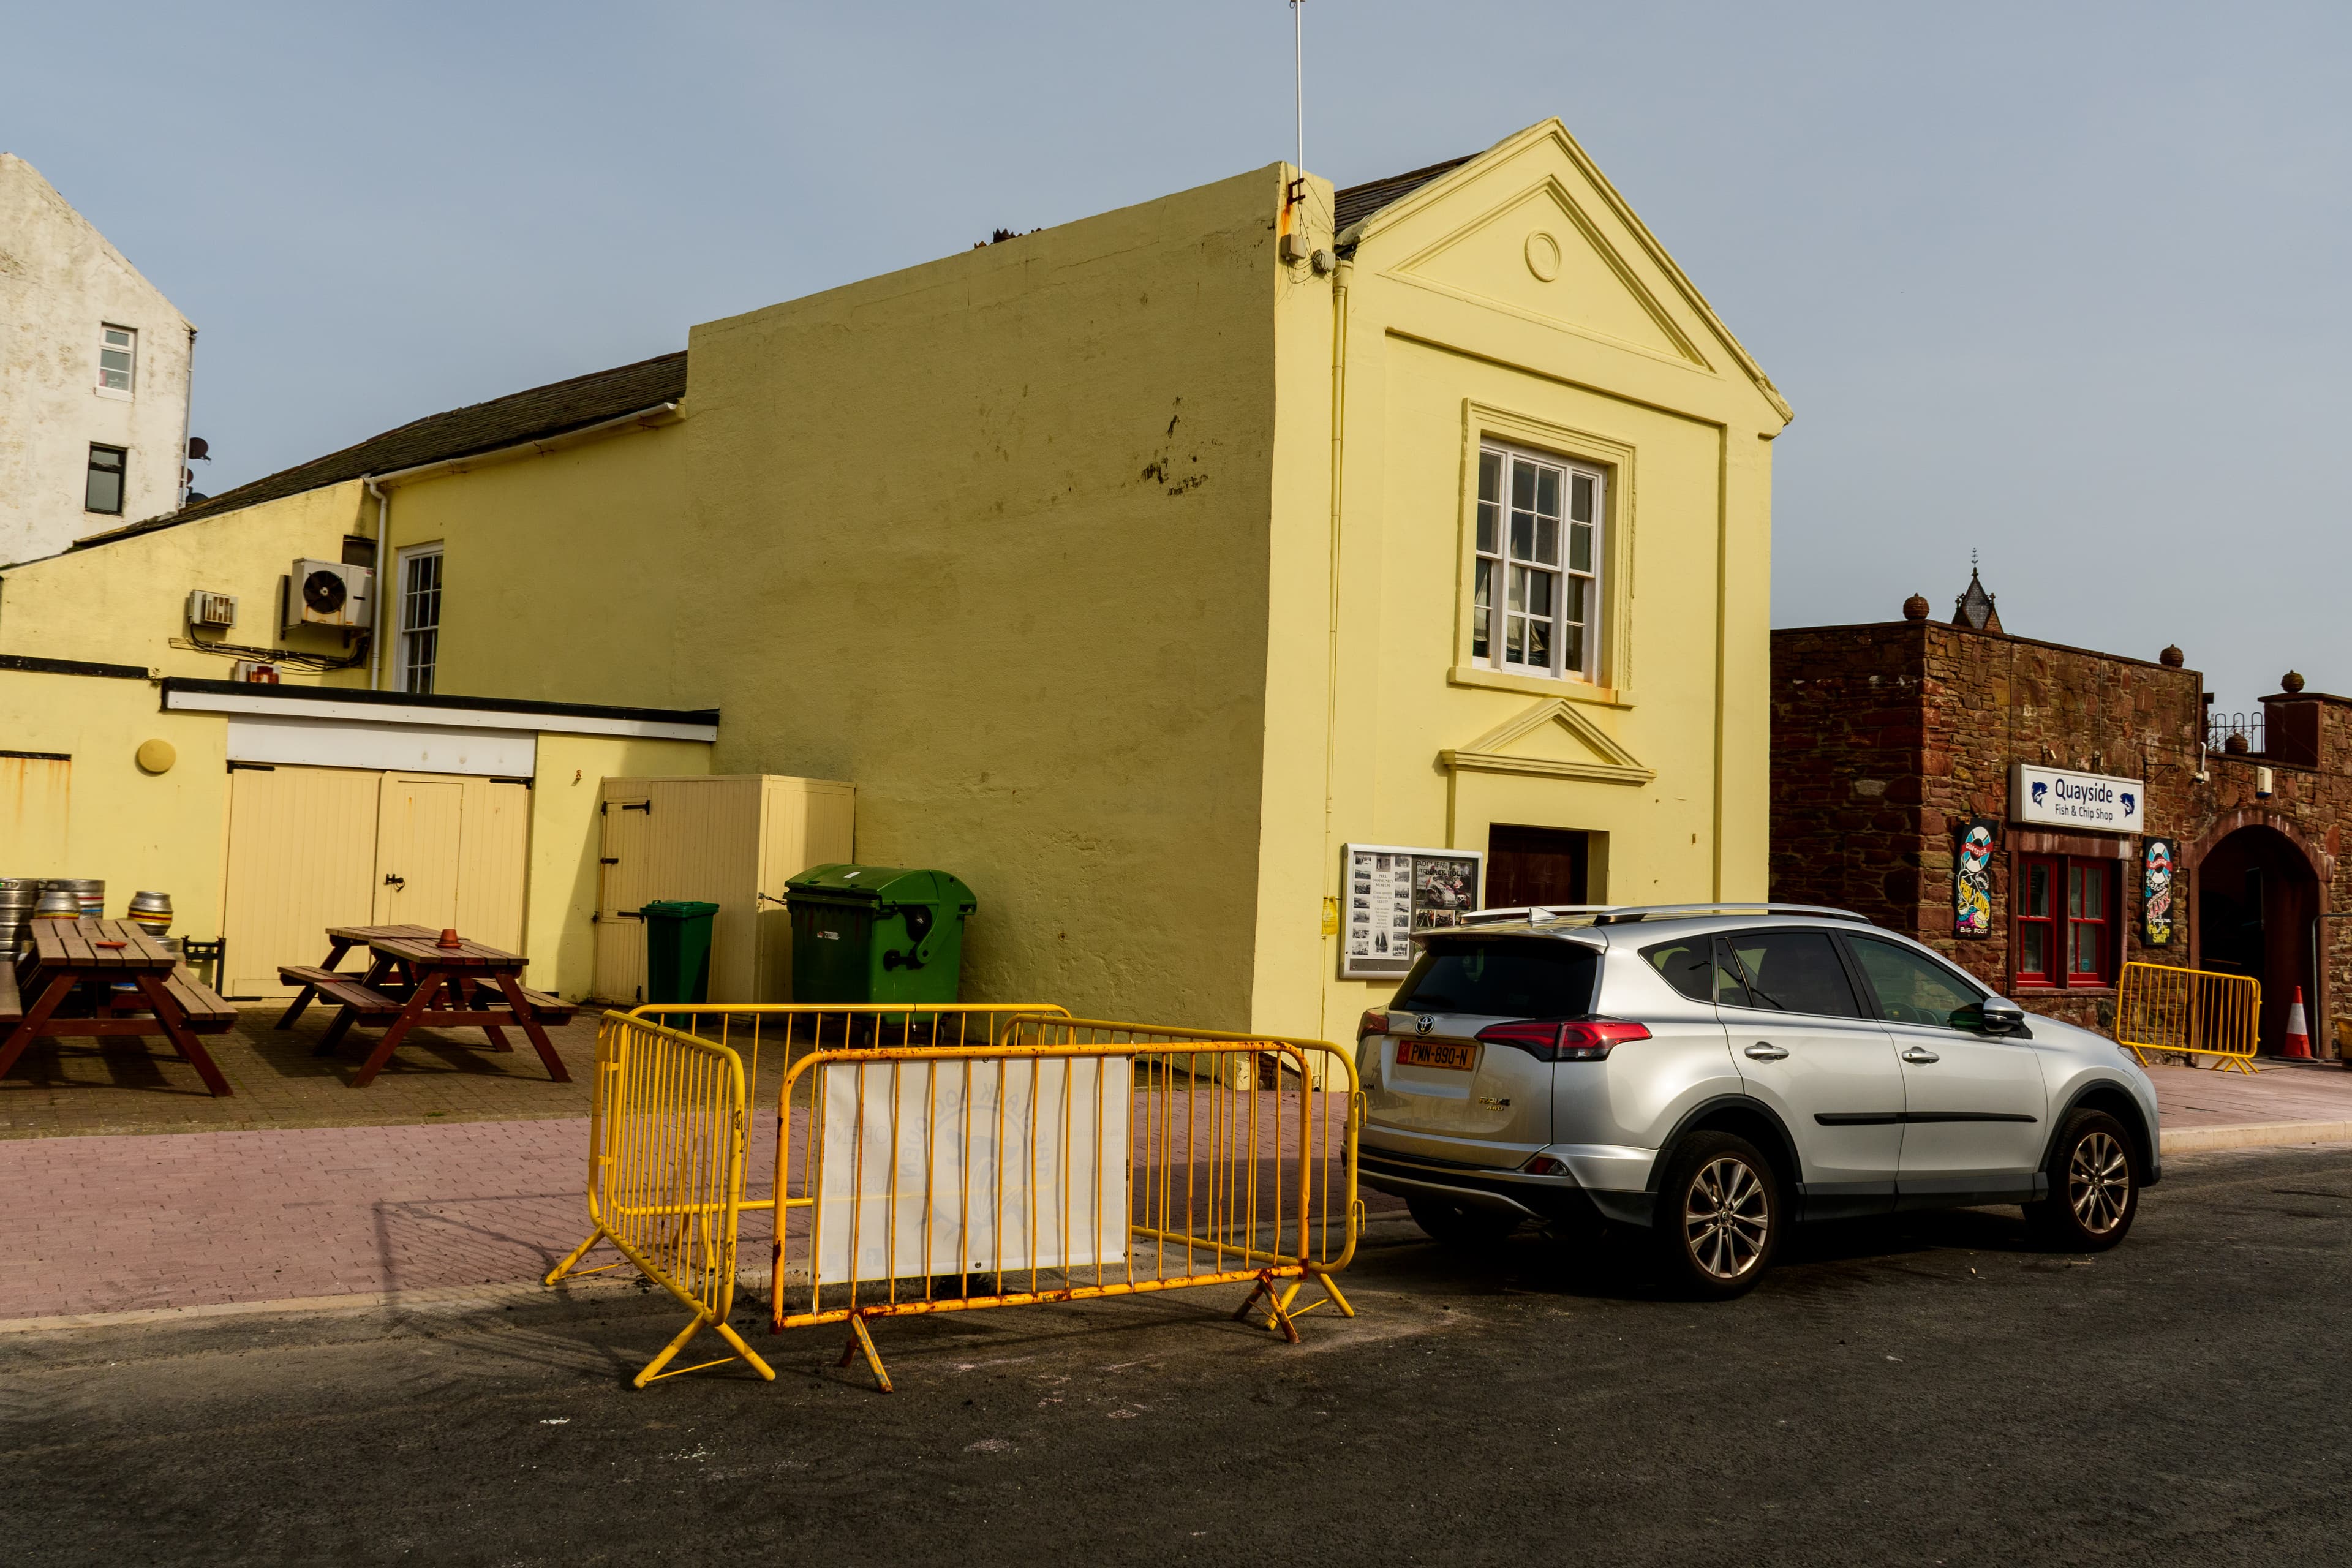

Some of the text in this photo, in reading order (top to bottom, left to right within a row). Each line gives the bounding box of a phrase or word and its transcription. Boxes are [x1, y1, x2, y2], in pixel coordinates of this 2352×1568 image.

[2055, 778, 2113, 805] Quayside
[2055, 804, 2113, 823] Fish & Chip Shop
[1966, 843, 1988, 856] QUAYSIDE
[1960, 877, 1973, 903] FISH
[1974, 891, 1989, 920] CHIPS
[1411, 1044, 1468, 1066] PMN-890-N
